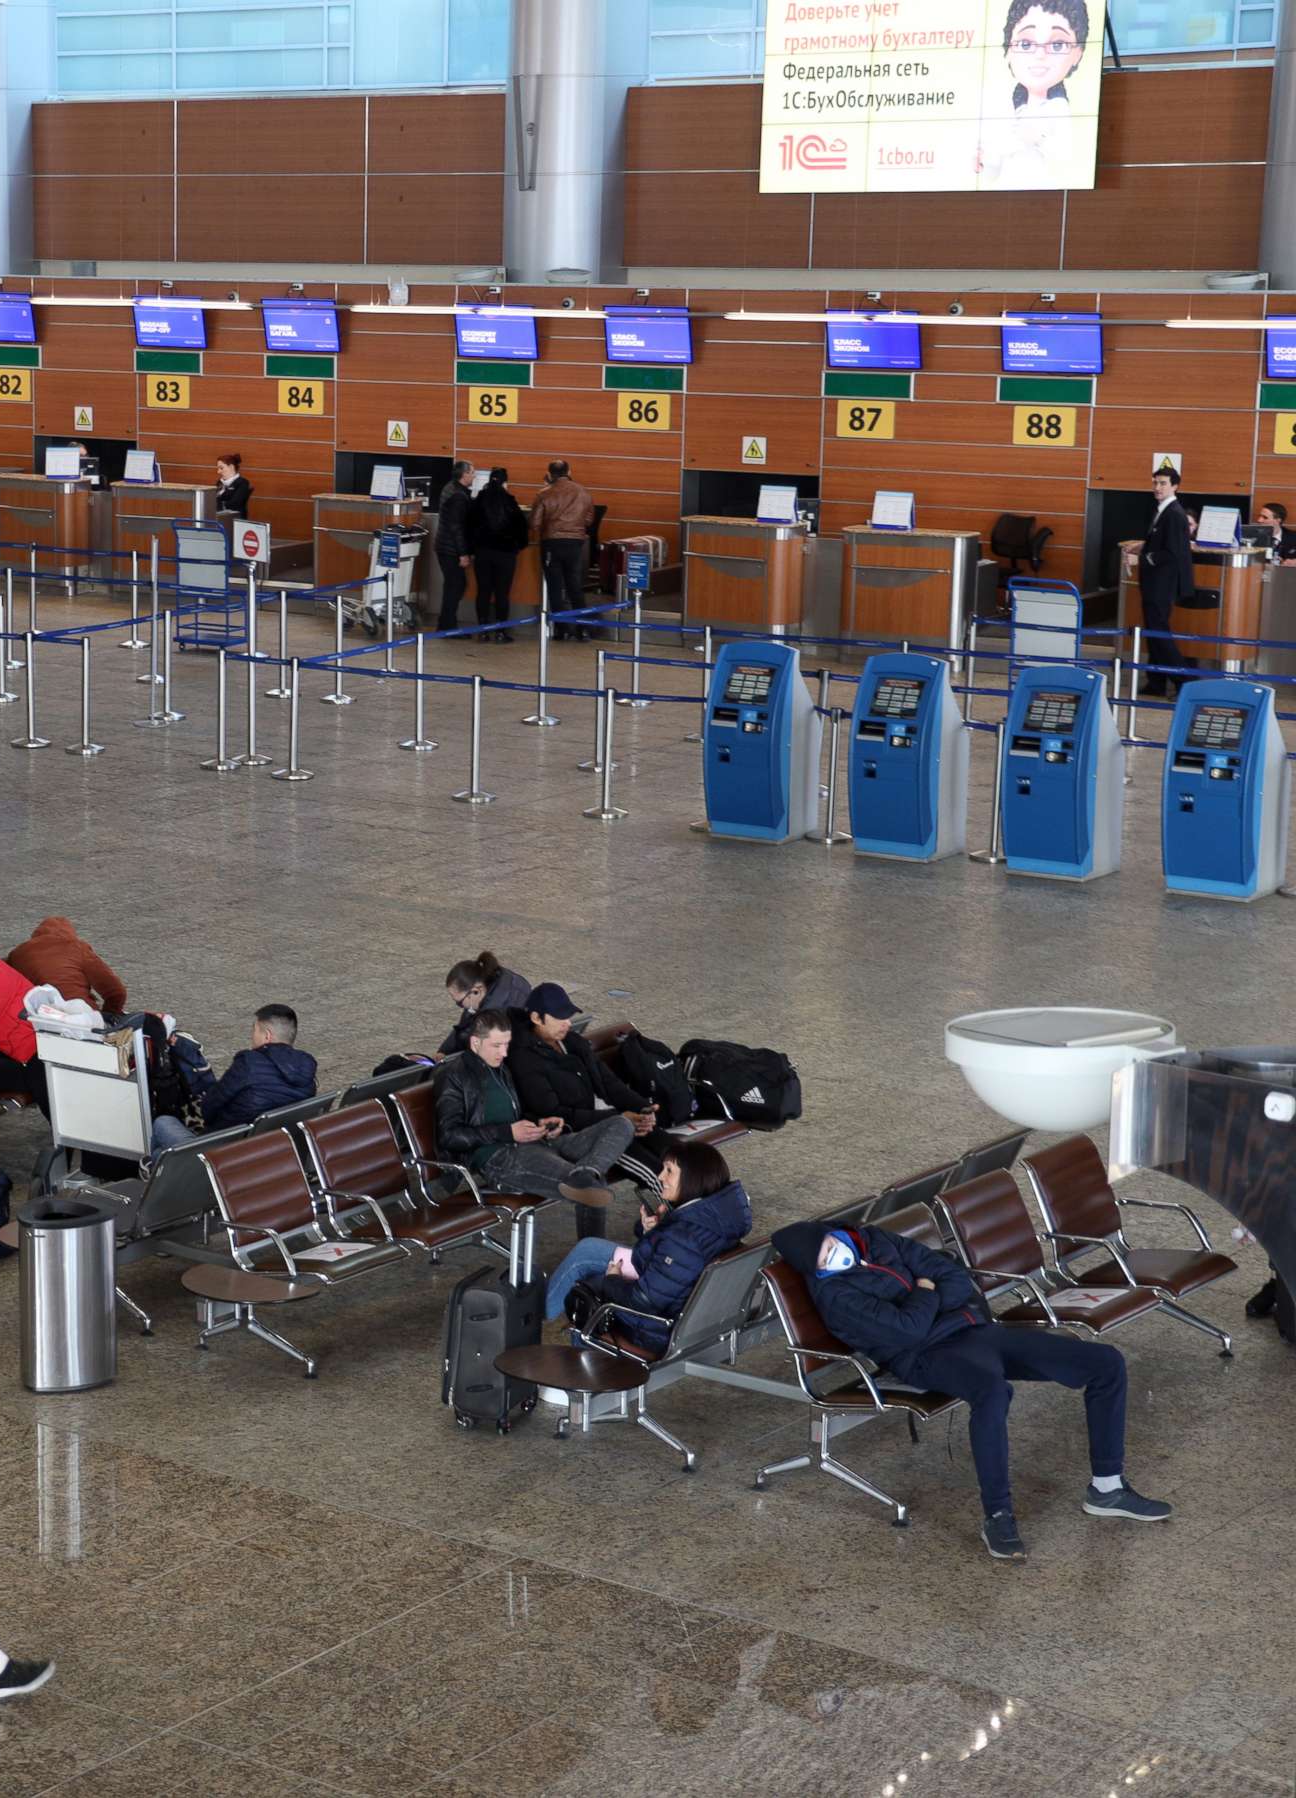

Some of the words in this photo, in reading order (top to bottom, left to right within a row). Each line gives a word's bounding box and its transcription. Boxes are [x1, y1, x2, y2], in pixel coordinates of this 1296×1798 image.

[785, 2, 859, 24] Доверьте
[865, 2, 899, 21] учет
[784, 33, 878, 55] грамотному
[883, 29, 975, 51] бухгалтеру
[783, 62, 890, 83] Федеральная
[896, 62, 930, 77] сеть
[782, 90, 955, 113] 1С:БухОбслуживание
[877, 147, 935, 166] 1cbo.ru
[0, 374, 22, 395] 82
[156, 381, 180, 402] 83
[287, 386, 314, 408] 84
[479, 393, 507, 416] 85
[628, 399, 658, 423] 86
[849, 407, 882, 431] 87
[1026, 413, 1062, 438] 88
[740, 1095, 766, 1104] adidas
